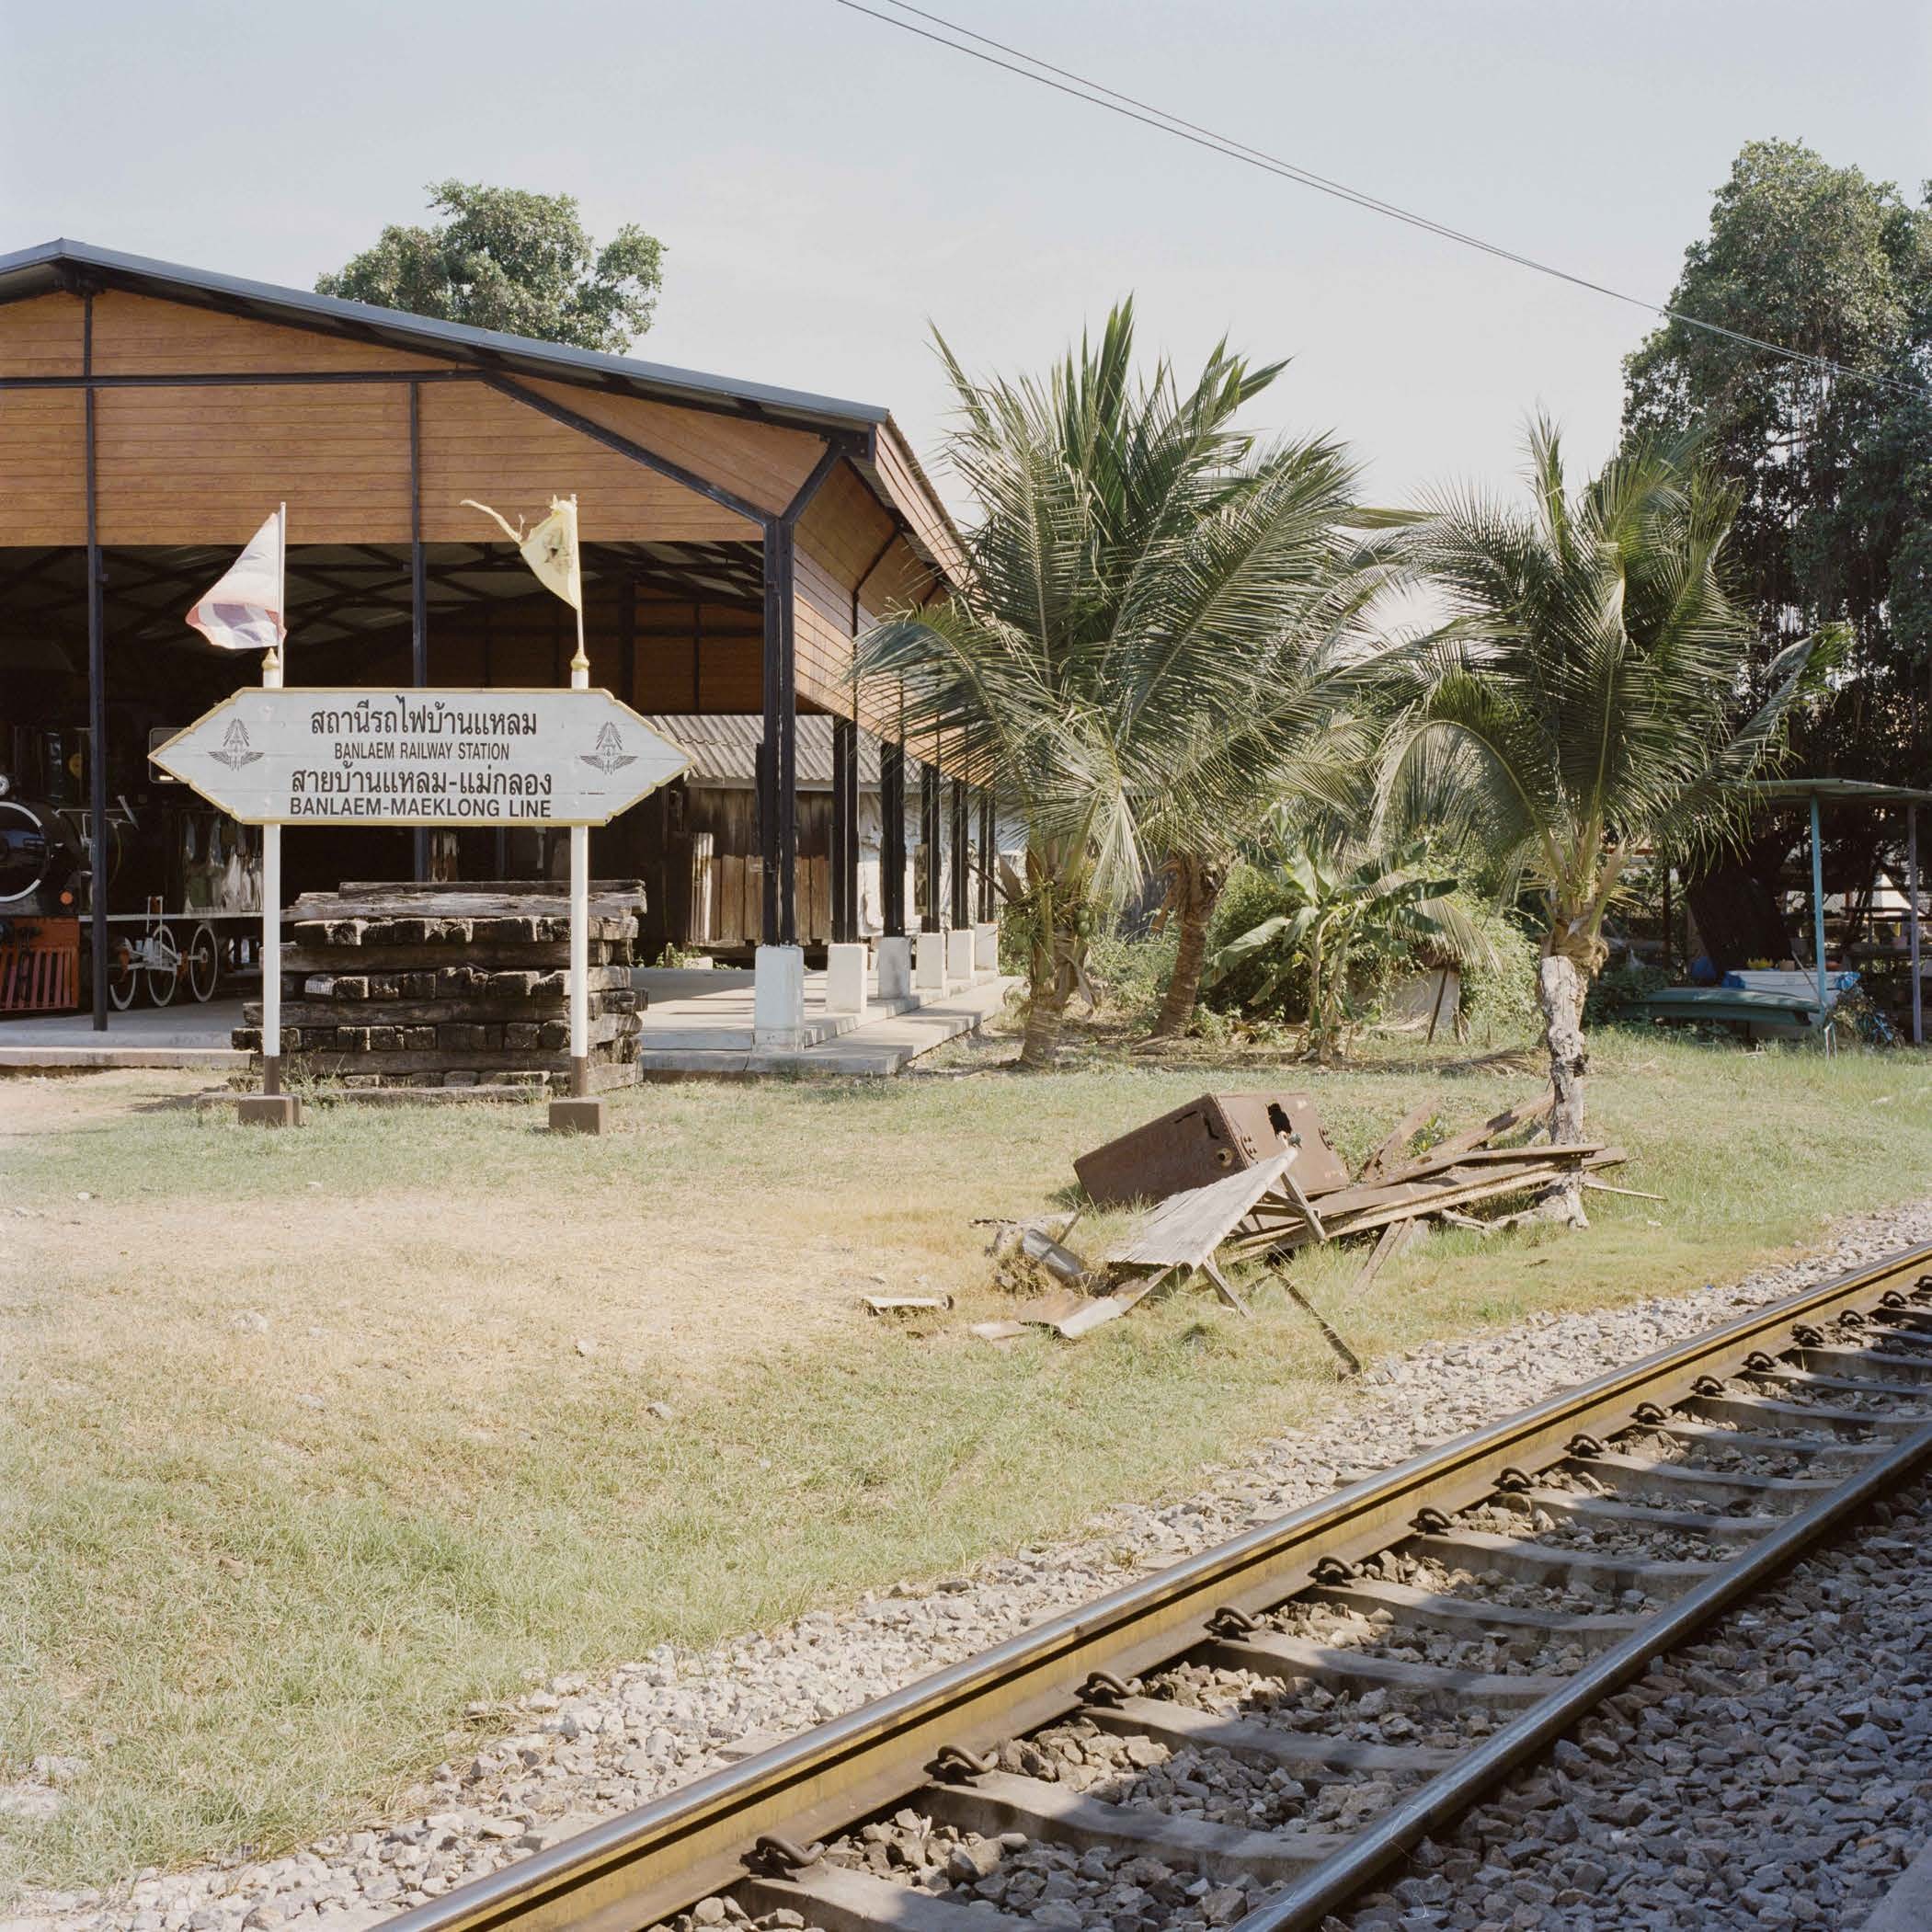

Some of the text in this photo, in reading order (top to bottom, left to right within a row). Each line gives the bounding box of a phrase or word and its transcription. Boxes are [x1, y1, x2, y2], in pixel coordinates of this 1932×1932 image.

[311, 695, 537, 736] สถานีรถไฟบ้านแหลม
[334, 741, 509, 760] BANLAEM RAILWAY STATION
[292, 760, 552, 795] สายบ้านแหลม-แม่กลอง
[290, 797, 552, 818] BANLAEM-MAEKLONG LINE
